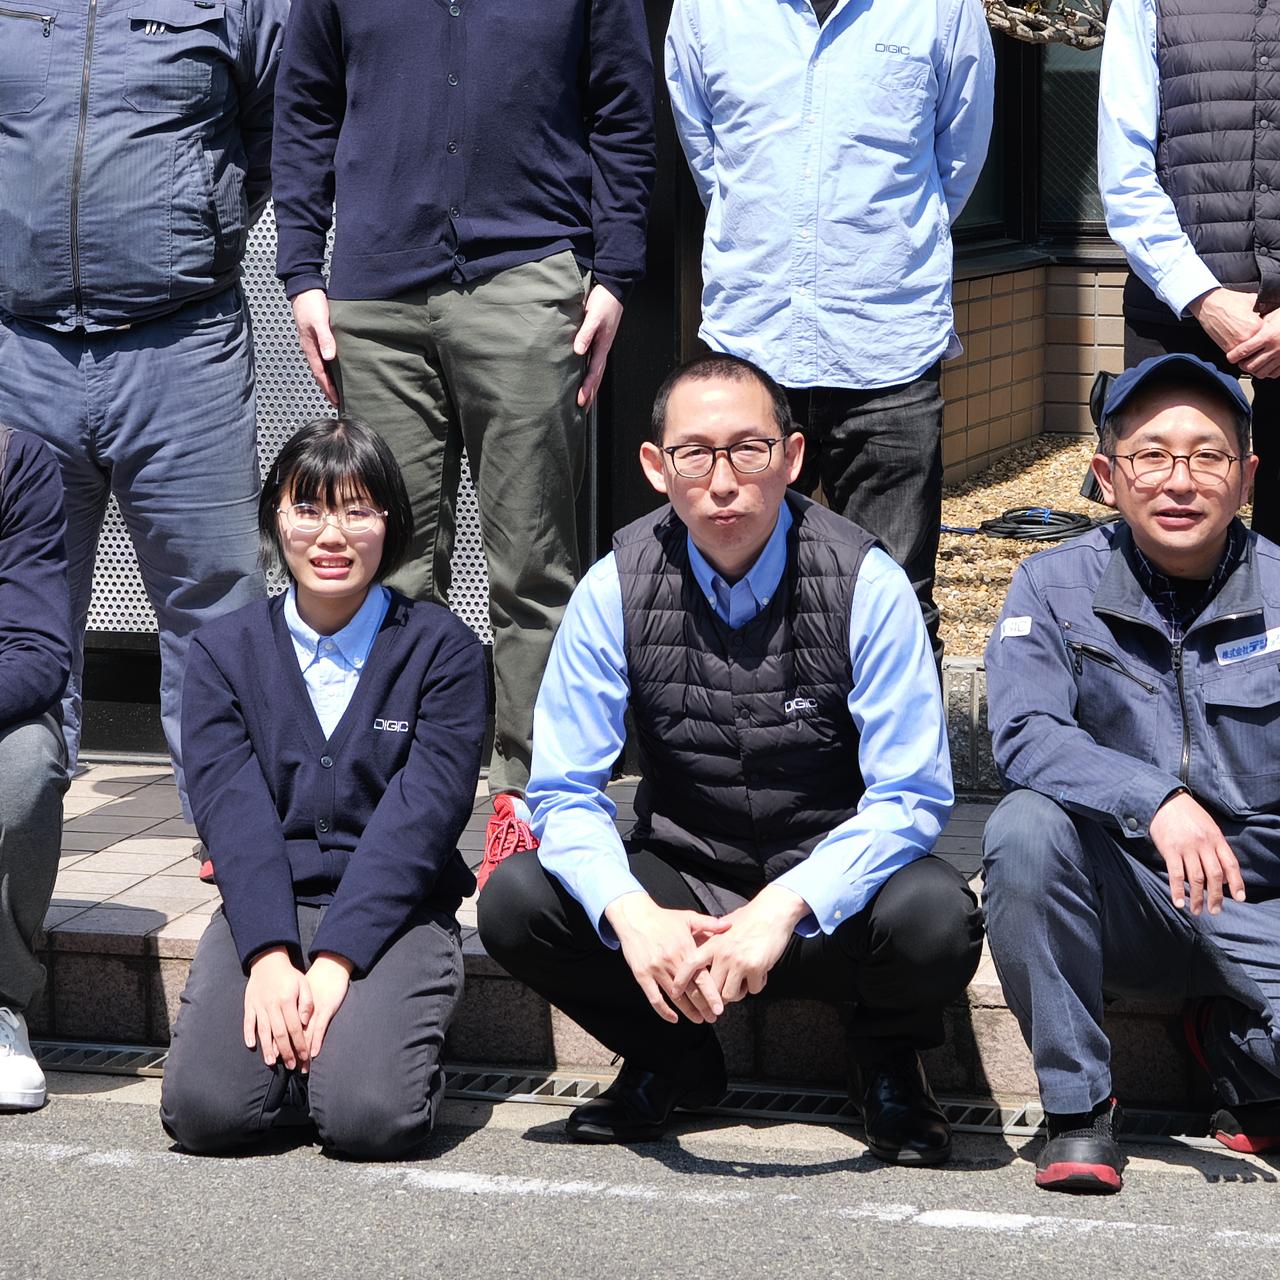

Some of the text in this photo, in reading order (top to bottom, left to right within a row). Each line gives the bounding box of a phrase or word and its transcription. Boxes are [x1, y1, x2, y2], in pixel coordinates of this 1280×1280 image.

[874, 43, 911, 56] DIGIC
[784, 697, 818, 713] DIGIC
[373, 718, 409, 733] DIGIC
